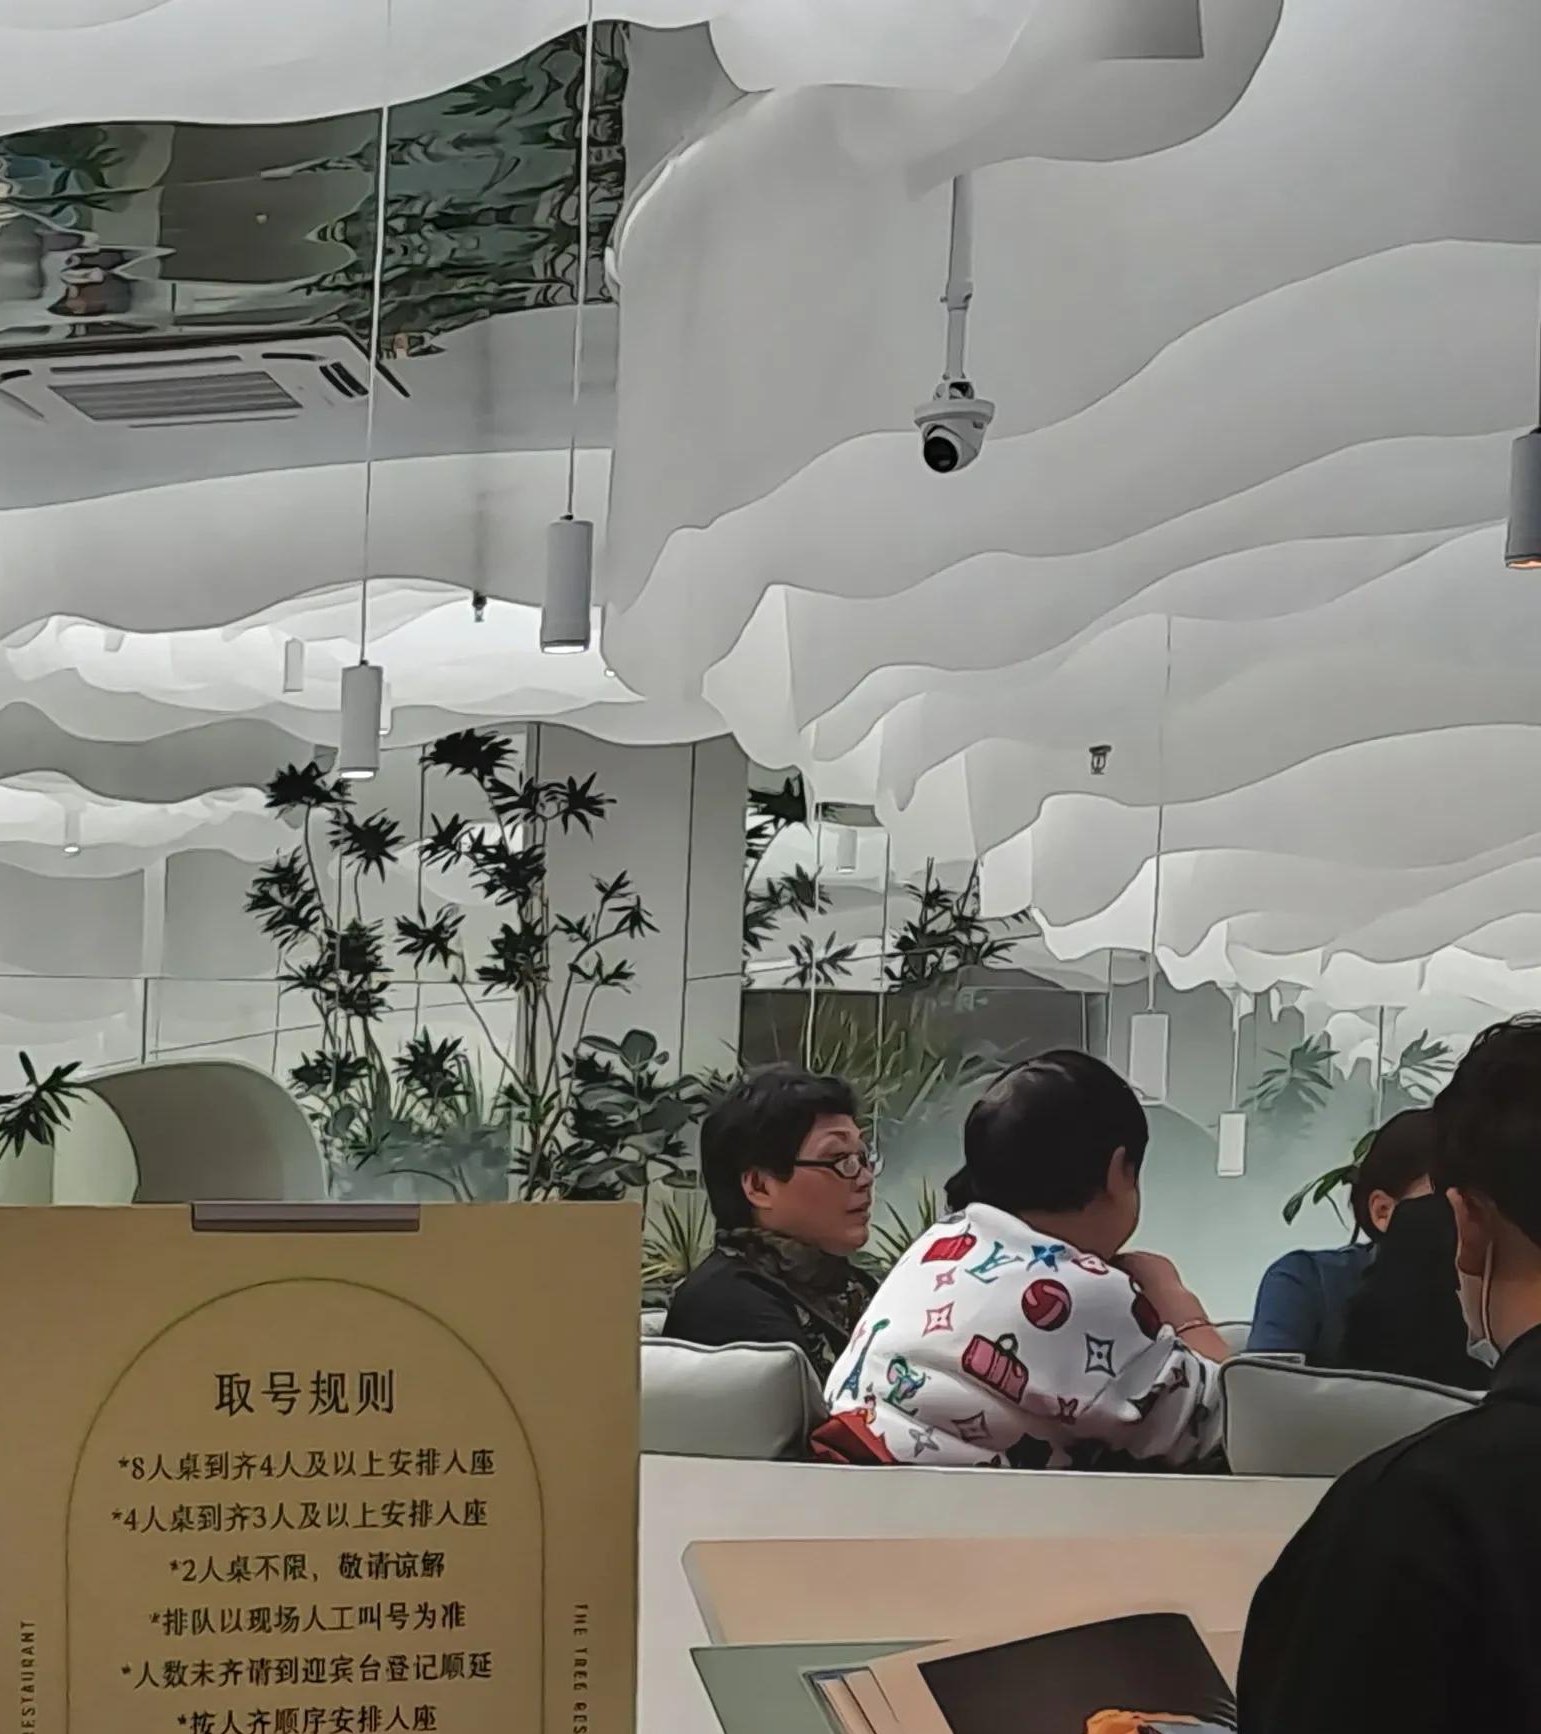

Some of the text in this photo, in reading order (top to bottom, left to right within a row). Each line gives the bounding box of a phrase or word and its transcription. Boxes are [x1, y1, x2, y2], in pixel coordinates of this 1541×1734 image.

[214, 1369, 394, 1417] 取号规则
[572, 1603, 589, 1636] THE
[572, 1647, 588, 1691] TREE
